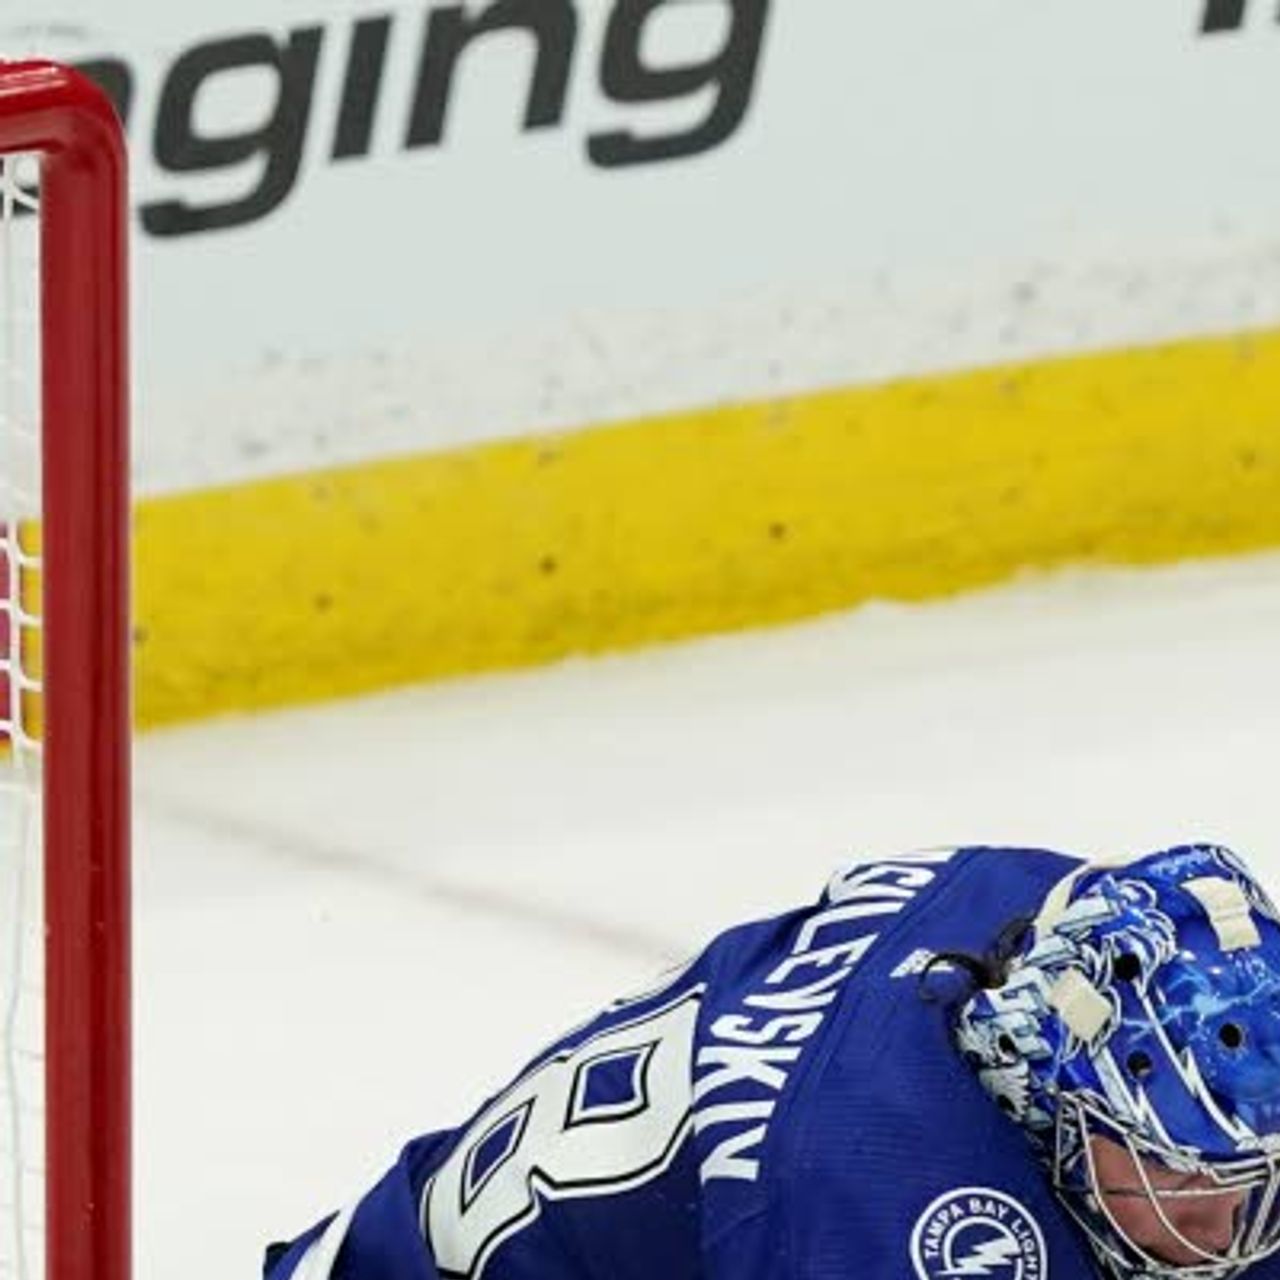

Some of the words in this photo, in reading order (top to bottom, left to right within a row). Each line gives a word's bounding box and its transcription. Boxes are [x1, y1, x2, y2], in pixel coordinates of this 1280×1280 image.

[72, 0, 773, 238] ging
[924, 1202, 964, 1259] TAMPA
[968, 1198, 1009, 1220] BAY
